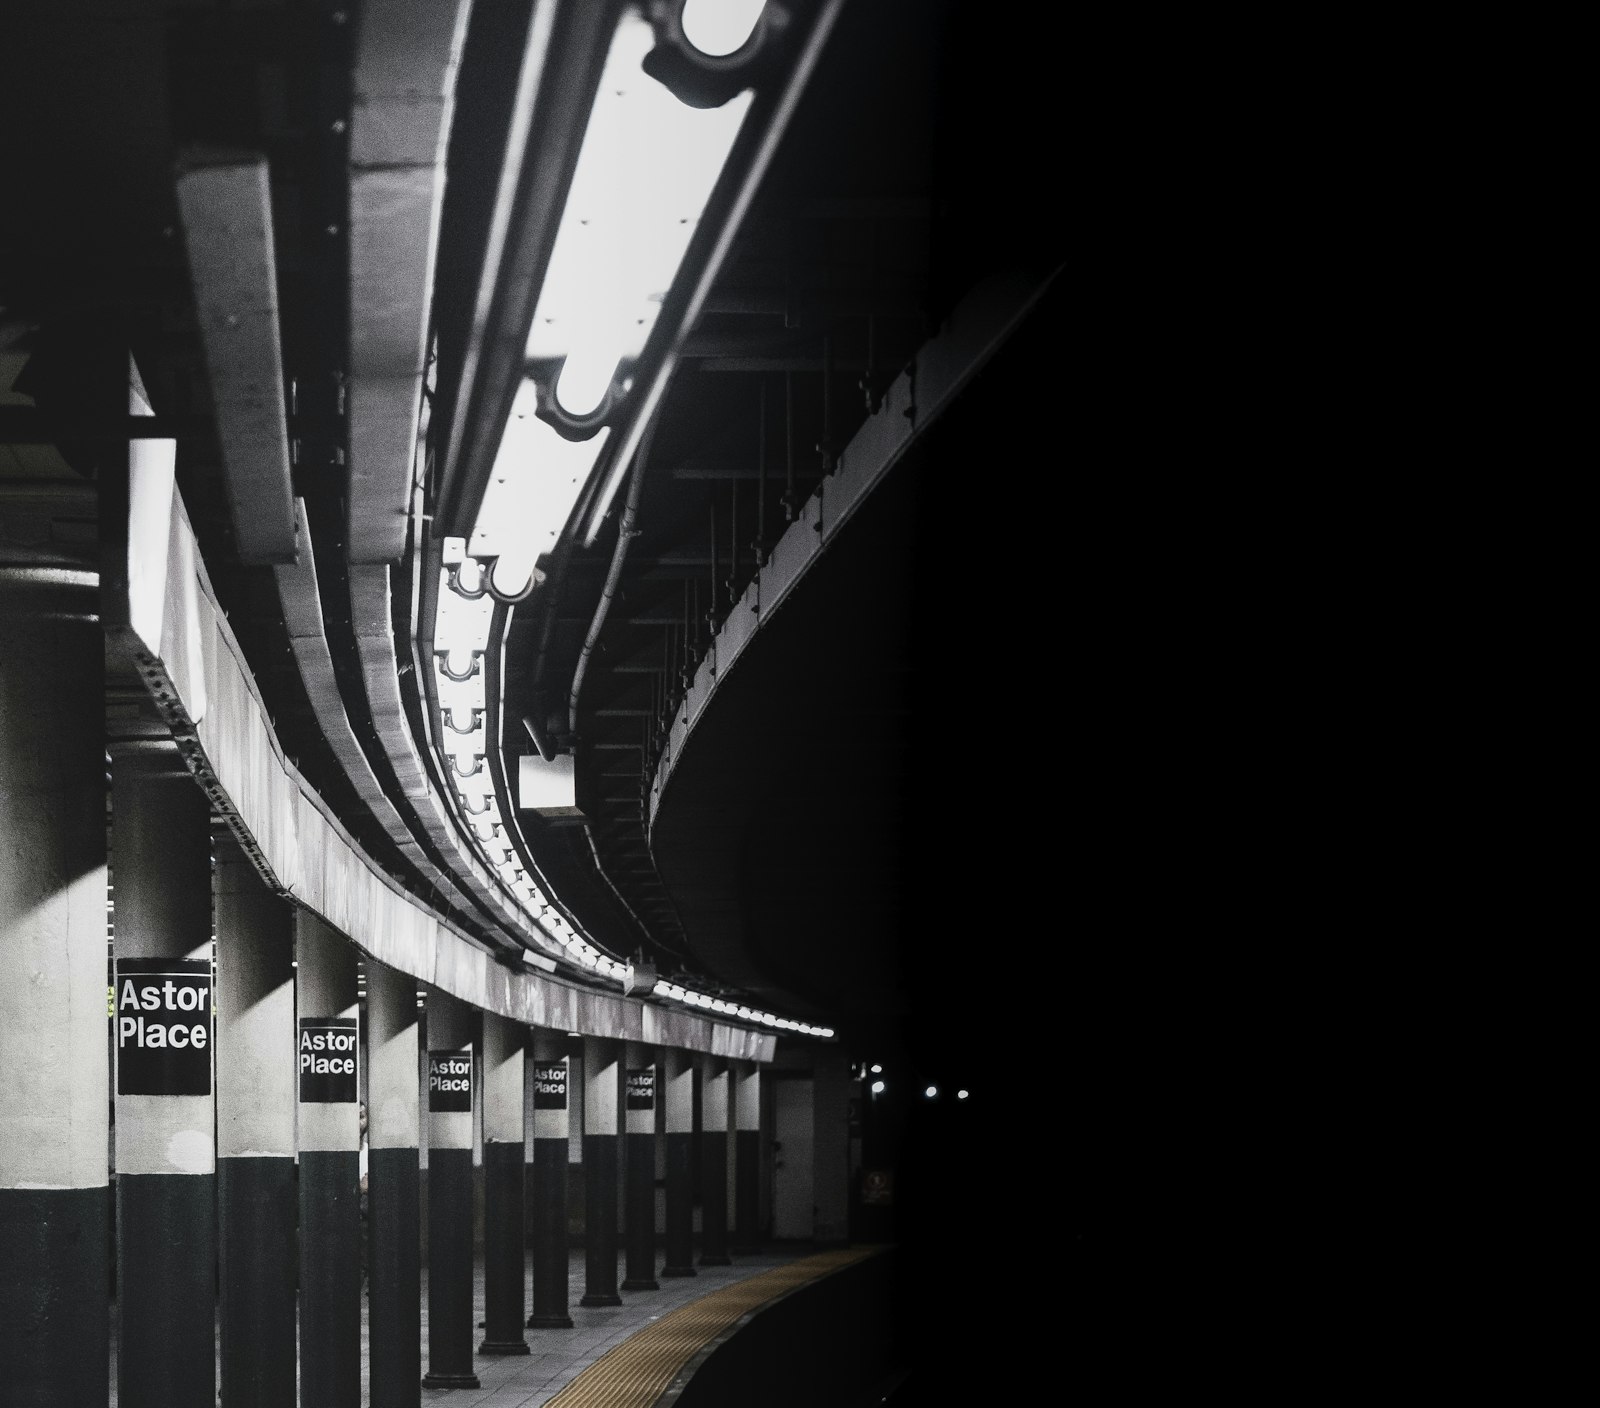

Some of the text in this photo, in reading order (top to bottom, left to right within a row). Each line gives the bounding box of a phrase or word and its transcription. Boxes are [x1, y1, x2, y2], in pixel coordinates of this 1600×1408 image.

[120, 979, 209, 1011] Astor
[119, 1016, 208, 1048] Place
[300, 1031, 355, 1051] Astor
[300, 1053, 355, 1074] Place
[429, 1059, 470, 1075] Astor
[535, 1068, 566, 1080] Astor
[429, 1076, 470, 1092] Place
[535, 1081, 565, 1094] Place
